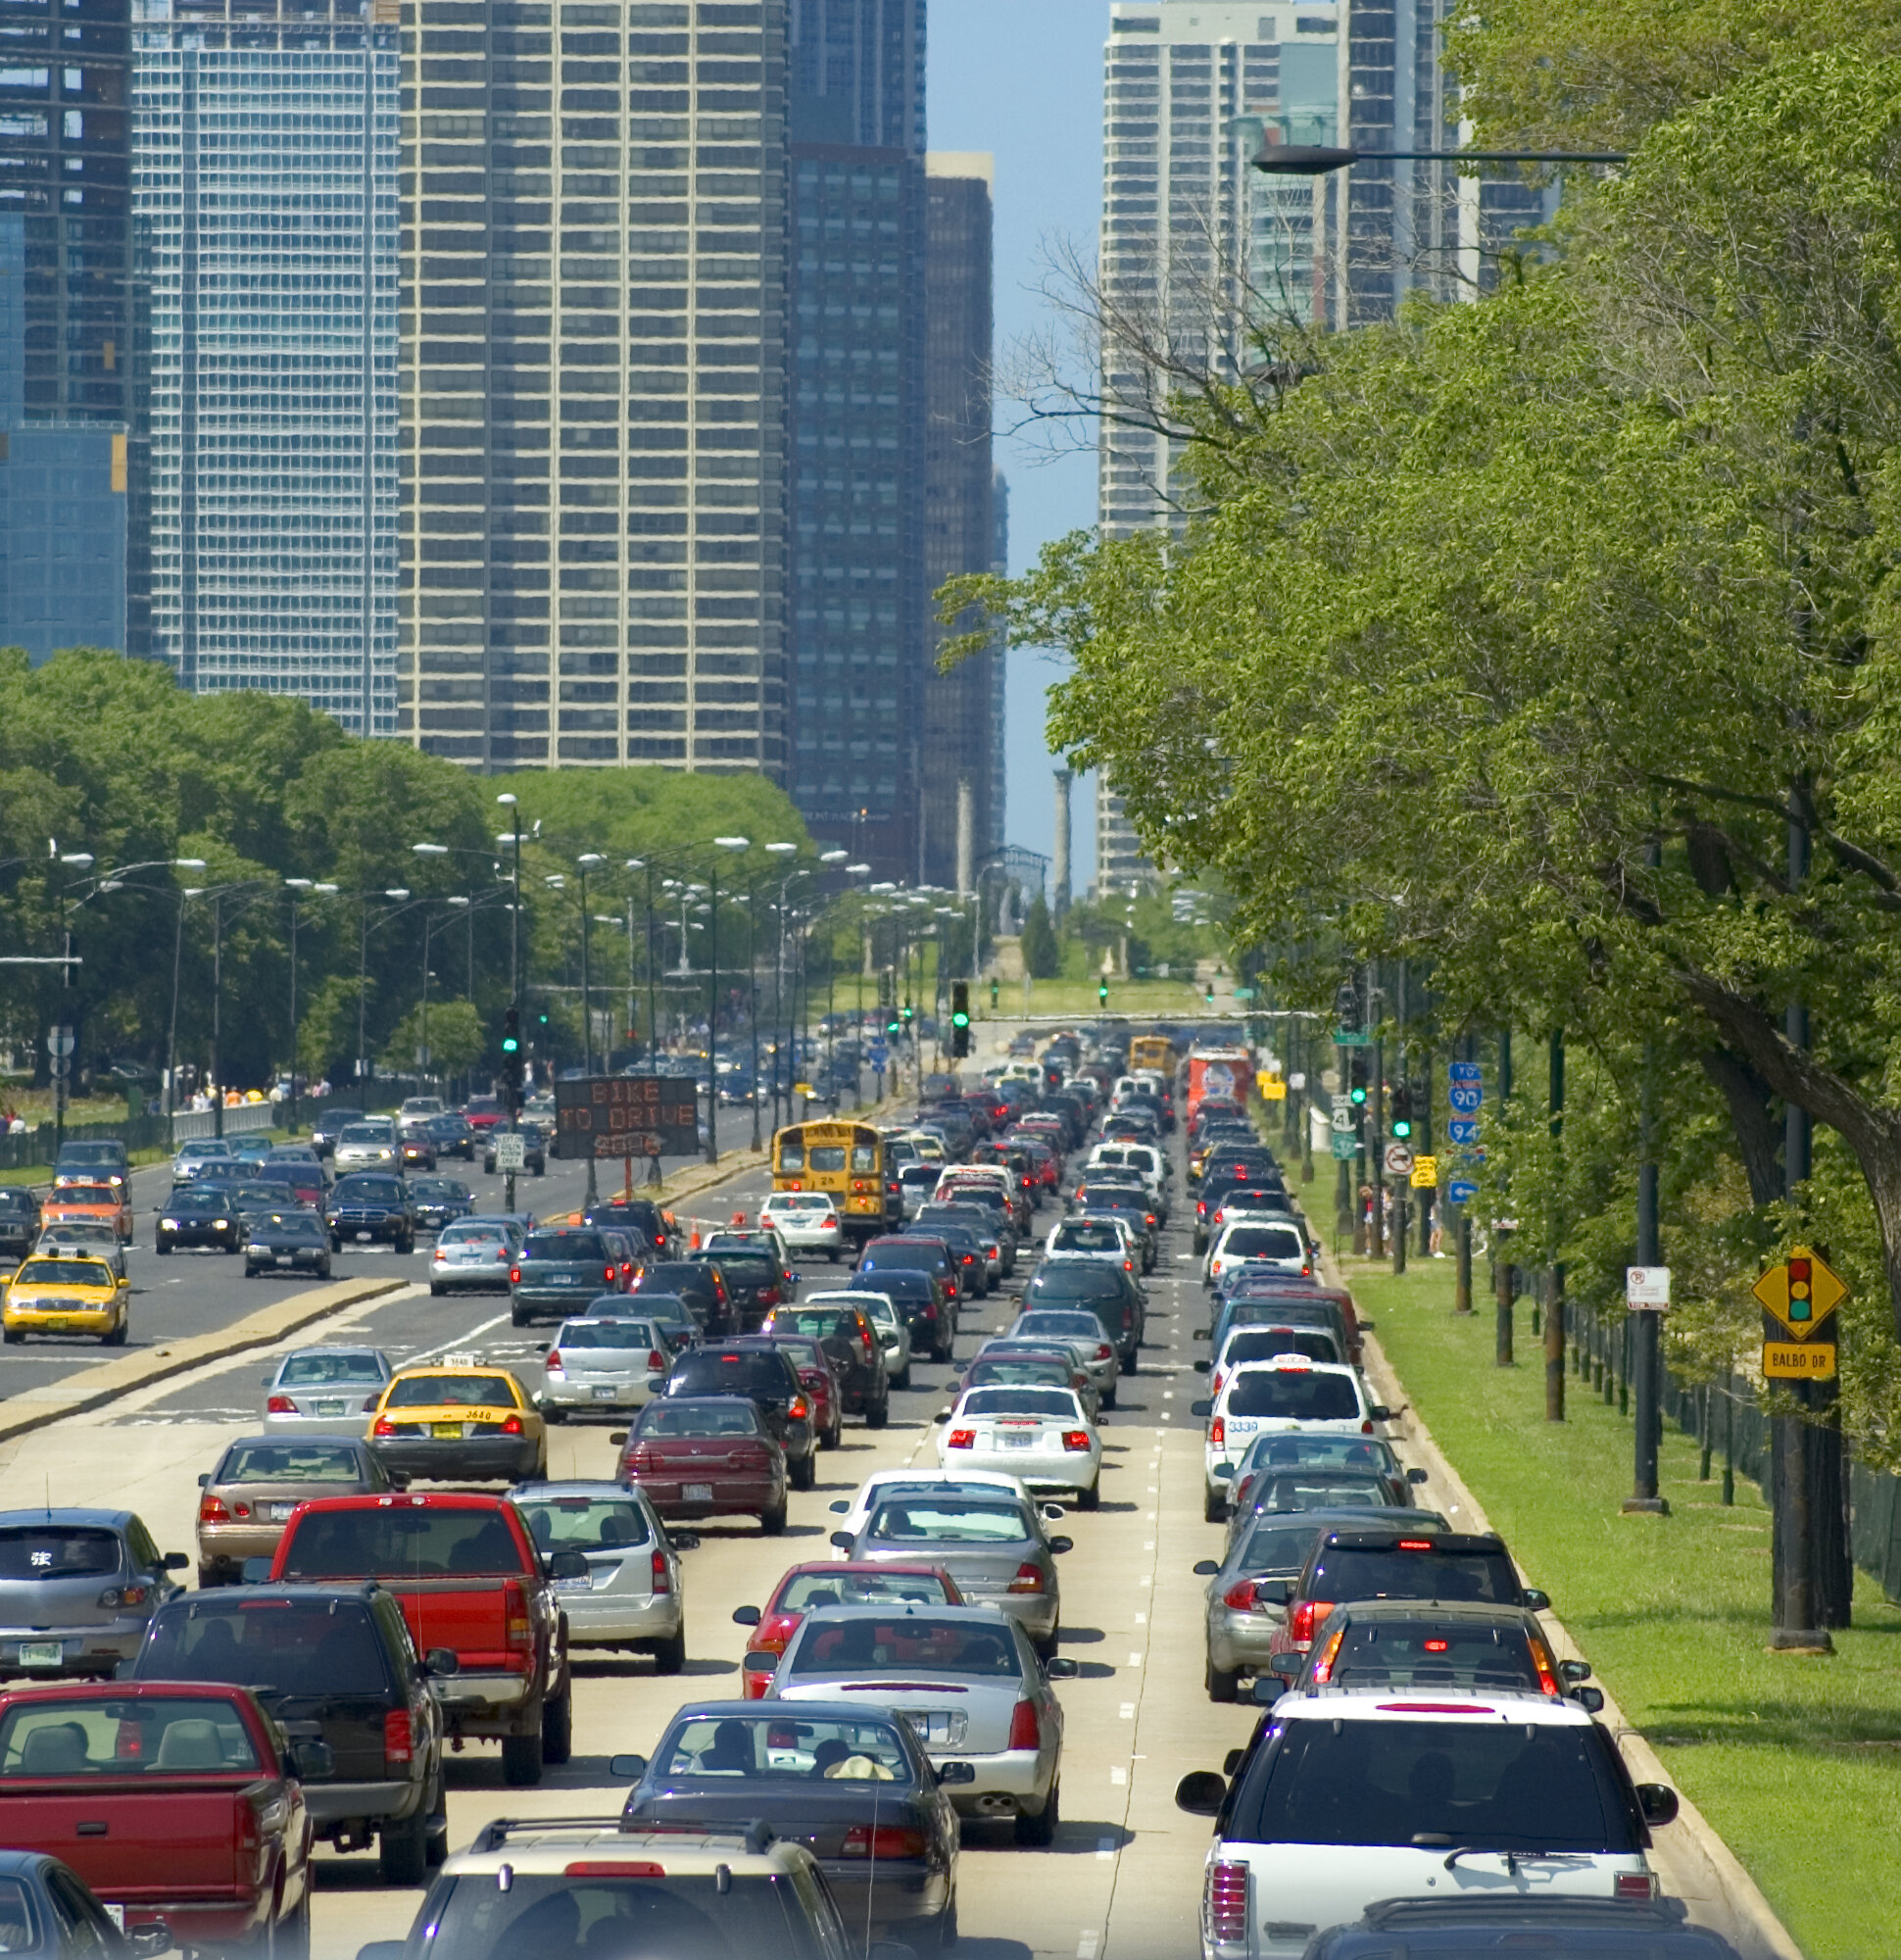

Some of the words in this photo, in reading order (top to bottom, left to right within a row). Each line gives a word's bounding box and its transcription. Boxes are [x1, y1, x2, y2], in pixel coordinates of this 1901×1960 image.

[592, 1080, 659, 1104] BIKE
[1455, 1091, 1478, 1106] 90
[560, 1108, 592, 1131] TO
[609, 1104, 695, 1130] DRIVE
[1454, 1124, 1477, 1140] 94
[1773, 1352, 1806, 1367] BALBO
[1812, 1354, 1827, 1368] DR
[466, 1410, 492, 1420] 3640
[1229, 1421, 1258, 1433] 3339
